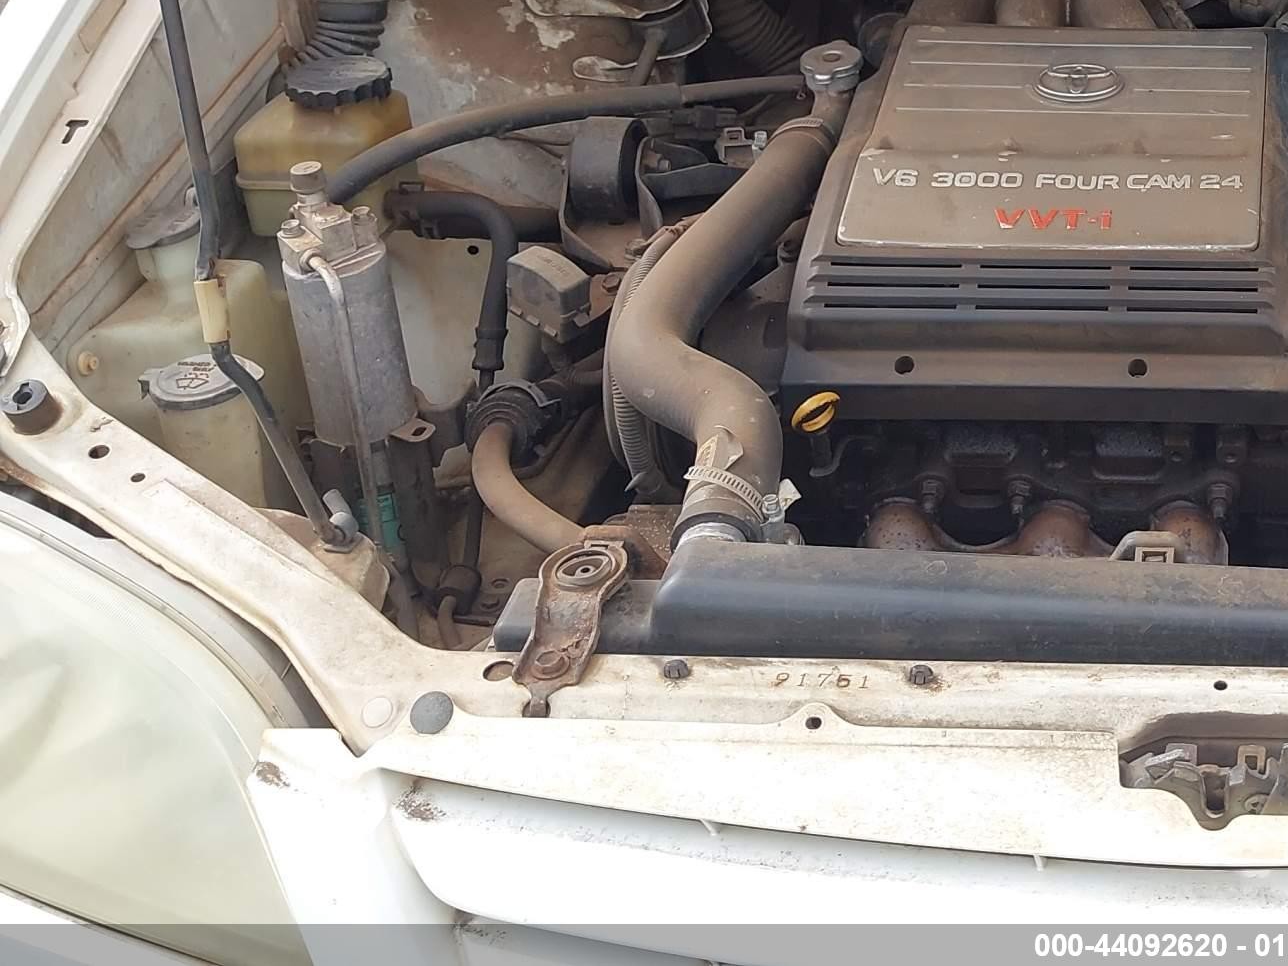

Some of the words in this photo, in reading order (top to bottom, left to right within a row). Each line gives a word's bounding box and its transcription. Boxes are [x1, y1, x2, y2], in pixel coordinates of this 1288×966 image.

[873, 168, 919, 187] V6
[931, 172, 1023, 188] 3000
[1035, 173, 1120, 190] FOUR
[1126, 174, 1191, 190] CAM
[1199, 174, 1243, 189] 24
[994, 208, 1113, 230] VVT-i
[776, 672, 869, 689] 91751
